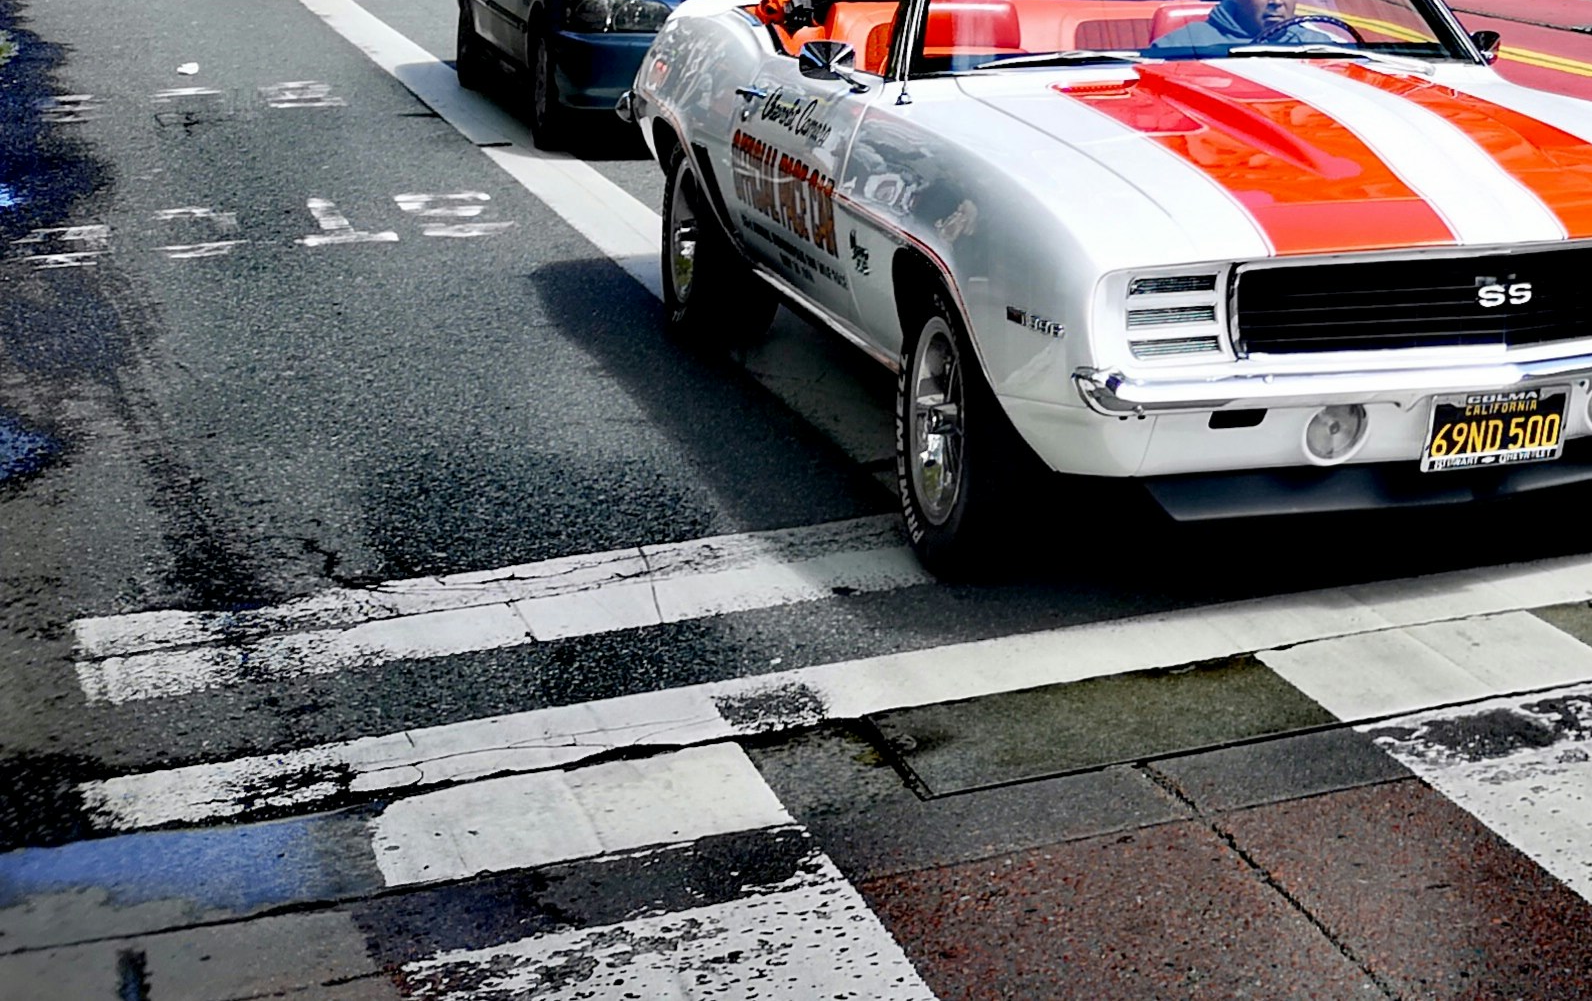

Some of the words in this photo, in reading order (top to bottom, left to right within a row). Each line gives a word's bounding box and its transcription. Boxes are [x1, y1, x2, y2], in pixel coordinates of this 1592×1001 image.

[1477, 282, 1533, 308] SS
[1465, 399, 1538, 417] CALIFORNIA
[1467, 390, 1539, 404] COLMA
[1430, 419, 1504, 458] 69ND
[1508, 413, 1560, 451] 500
